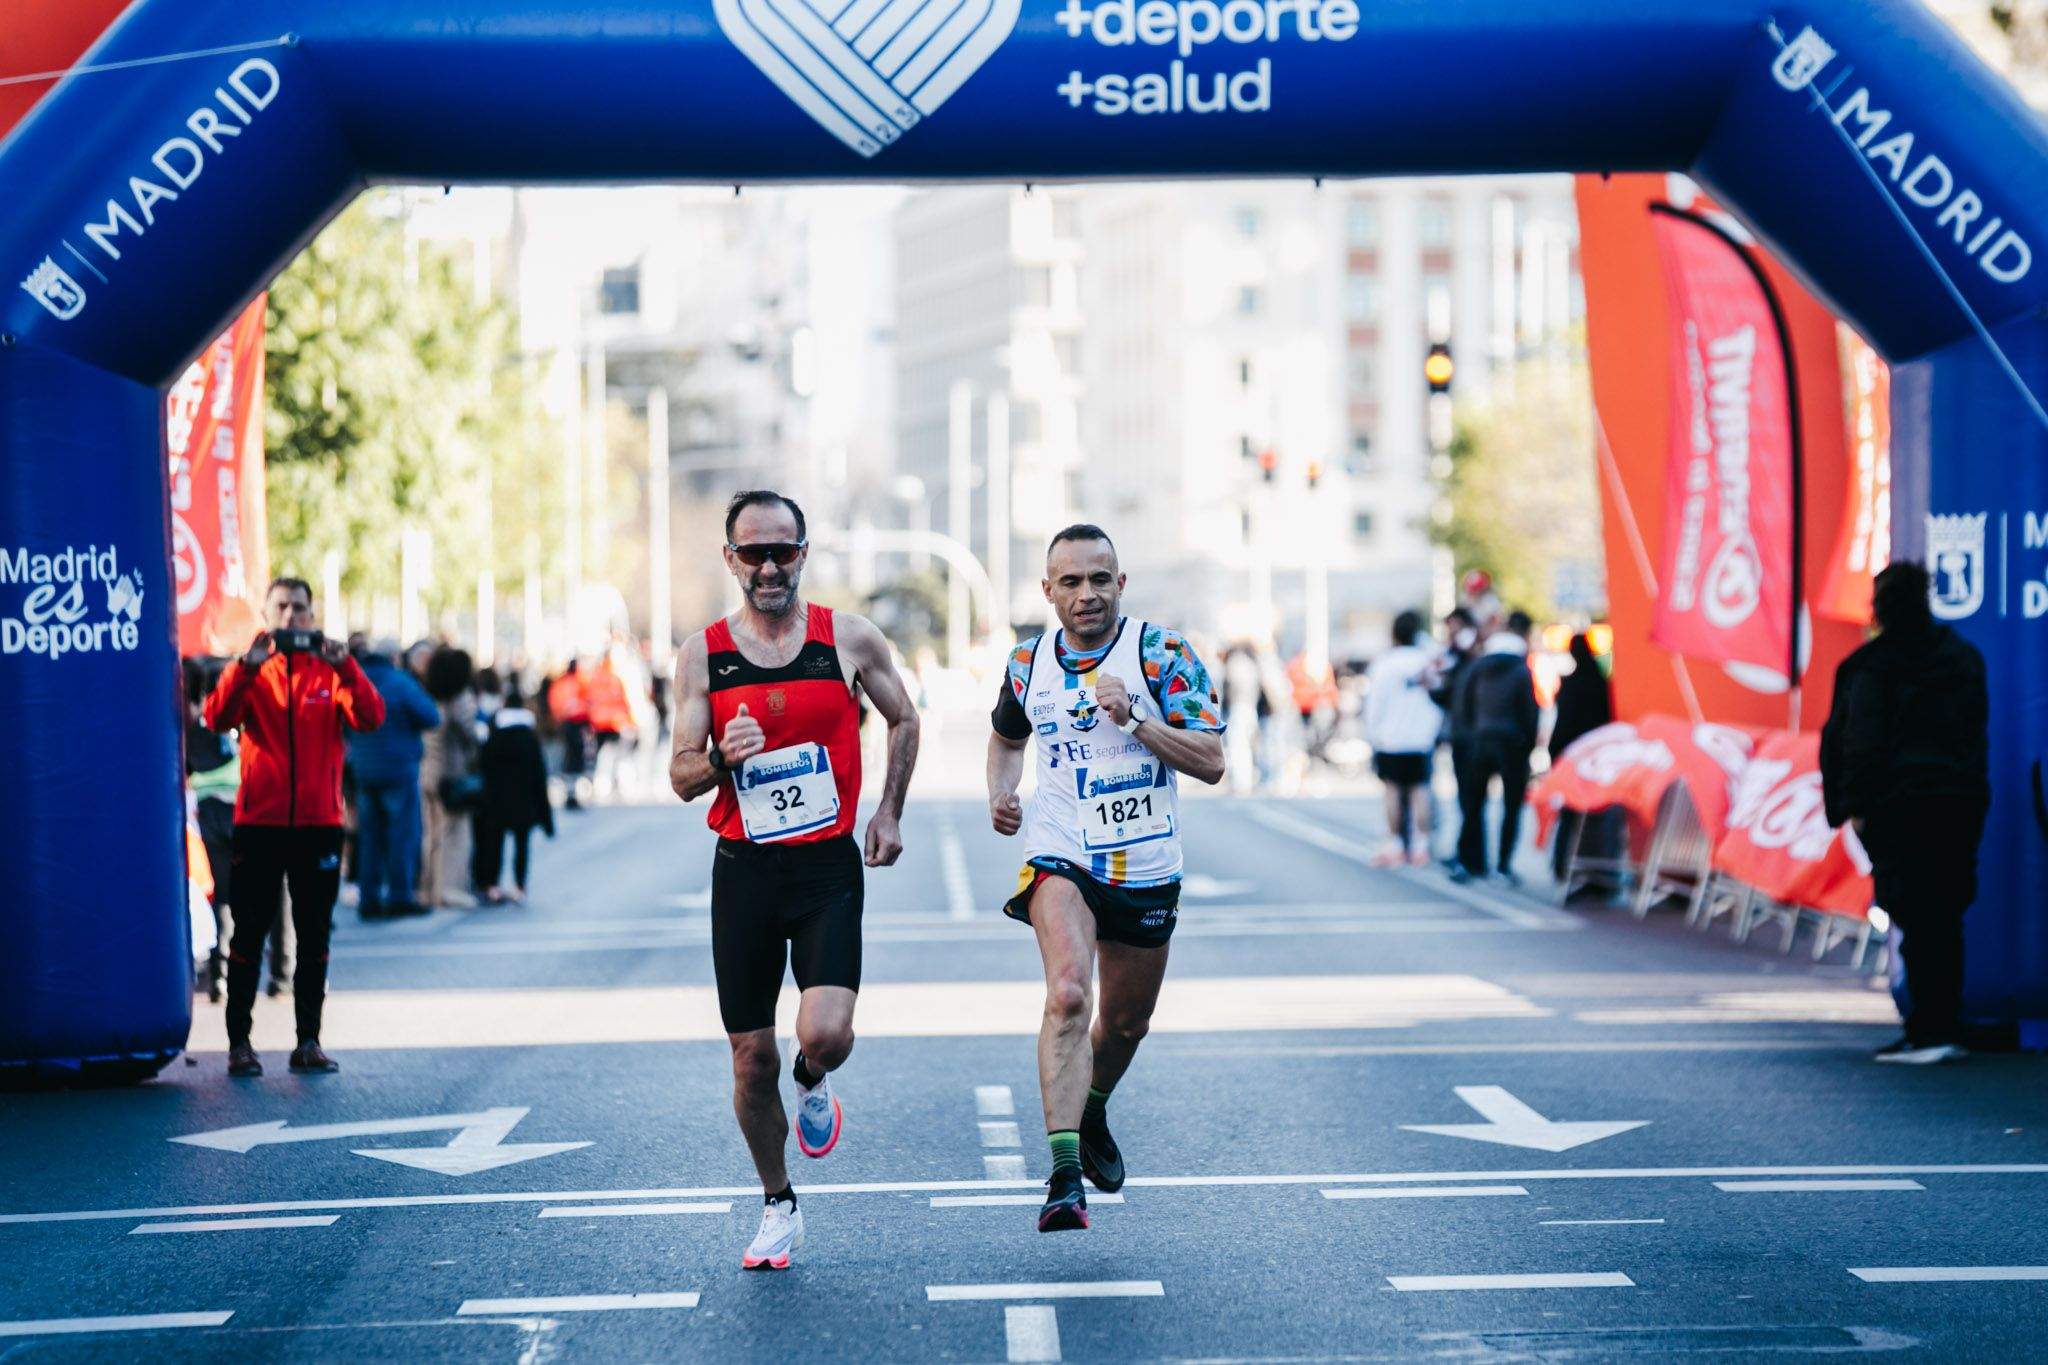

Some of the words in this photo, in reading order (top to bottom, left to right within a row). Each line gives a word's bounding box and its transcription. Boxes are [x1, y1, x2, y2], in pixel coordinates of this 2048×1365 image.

[1057, 57, 1272, 115] +salud
[84, 57, 281, 260] MADRID
[1831, 87, 2032, 283] MADRID
[0, 544, 117, 584] Madrid
[23, 584, 89, 624] es
[1, 617, 139, 661] Deporte
[760, 759, 811, 776] BOMBEROS
[1096, 741, 1143, 759] seguros
[770, 785, 805, 811] 32
[1103, 771, 1152, 786] BOMBEROS
[1095, 793, 1153, 825] 1821
